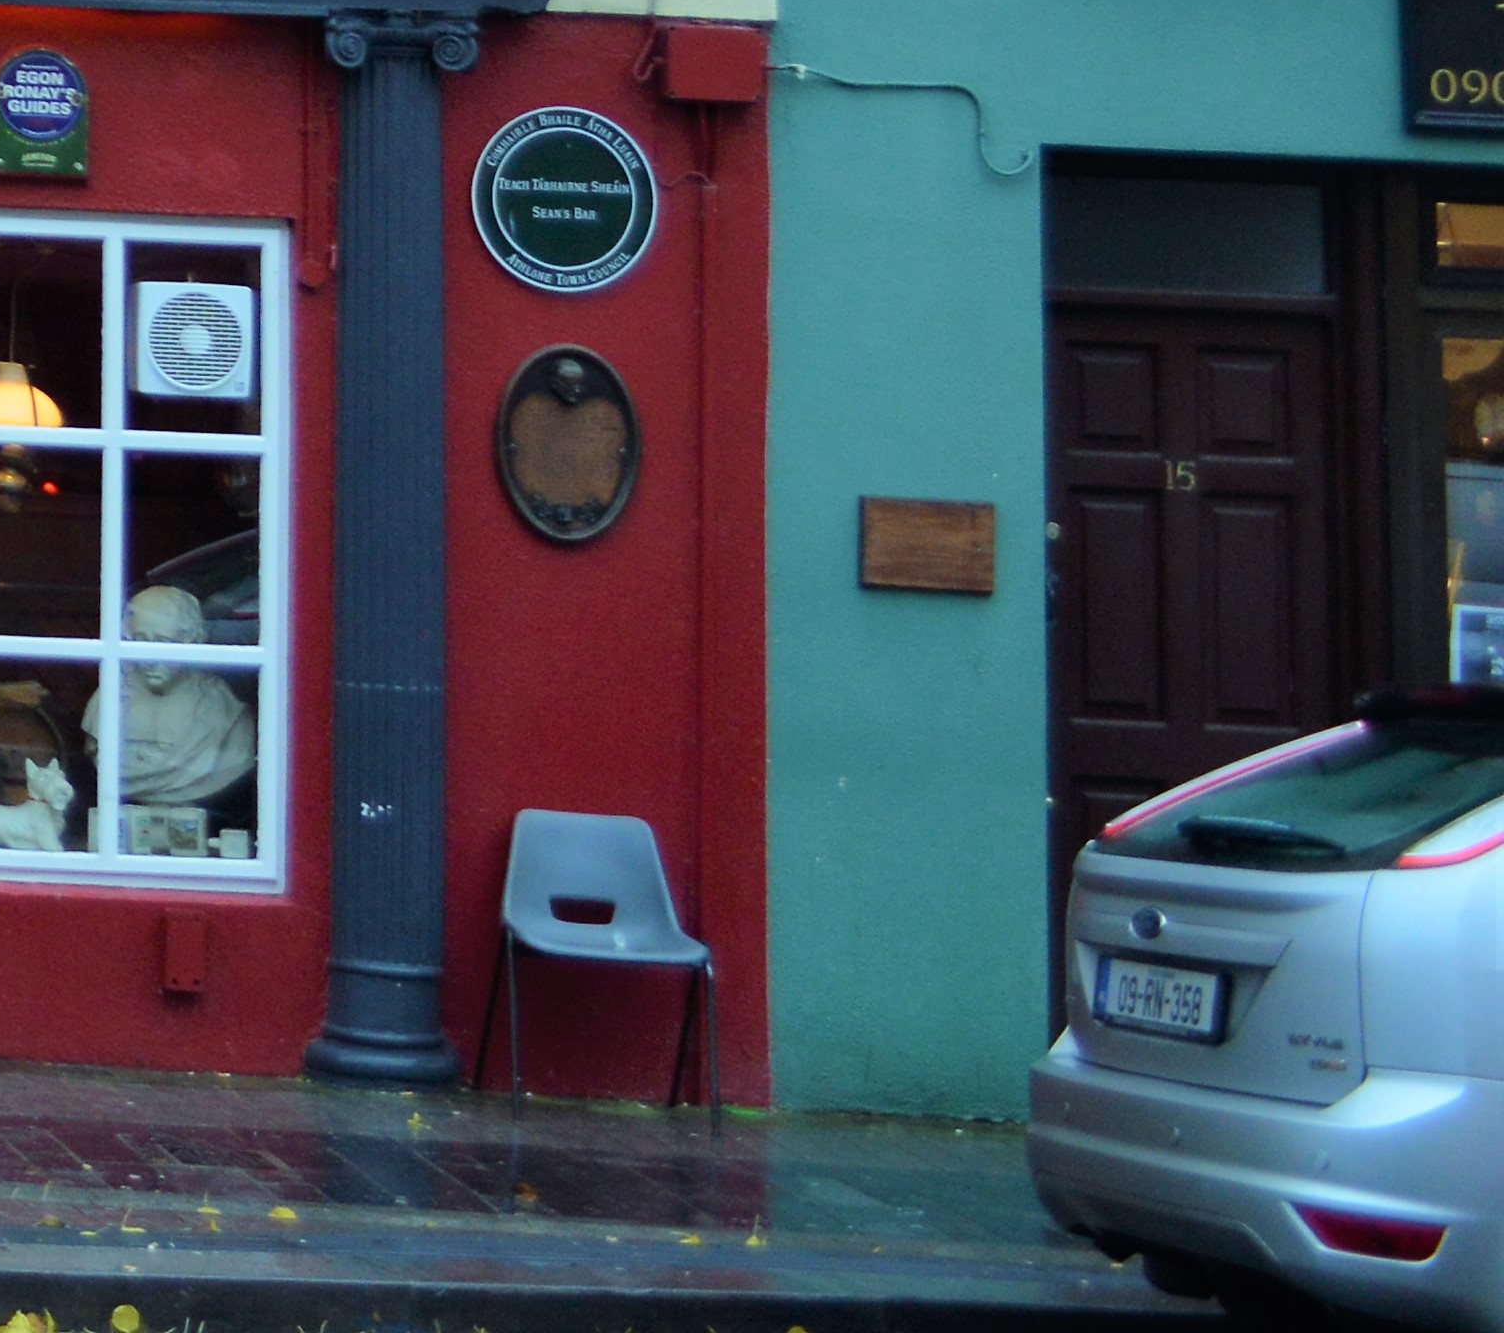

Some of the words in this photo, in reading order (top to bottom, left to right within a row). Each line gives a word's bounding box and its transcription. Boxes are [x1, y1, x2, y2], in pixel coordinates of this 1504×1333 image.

[14, 69, 65, 87] EGON
[3, 83, 78, 103] RONAY'S
[7, 98, 72, 116] GUIDES
[1165, 459, 1197, 491] 15
[1117, 974, 1203, 1026] 09-RN-358
